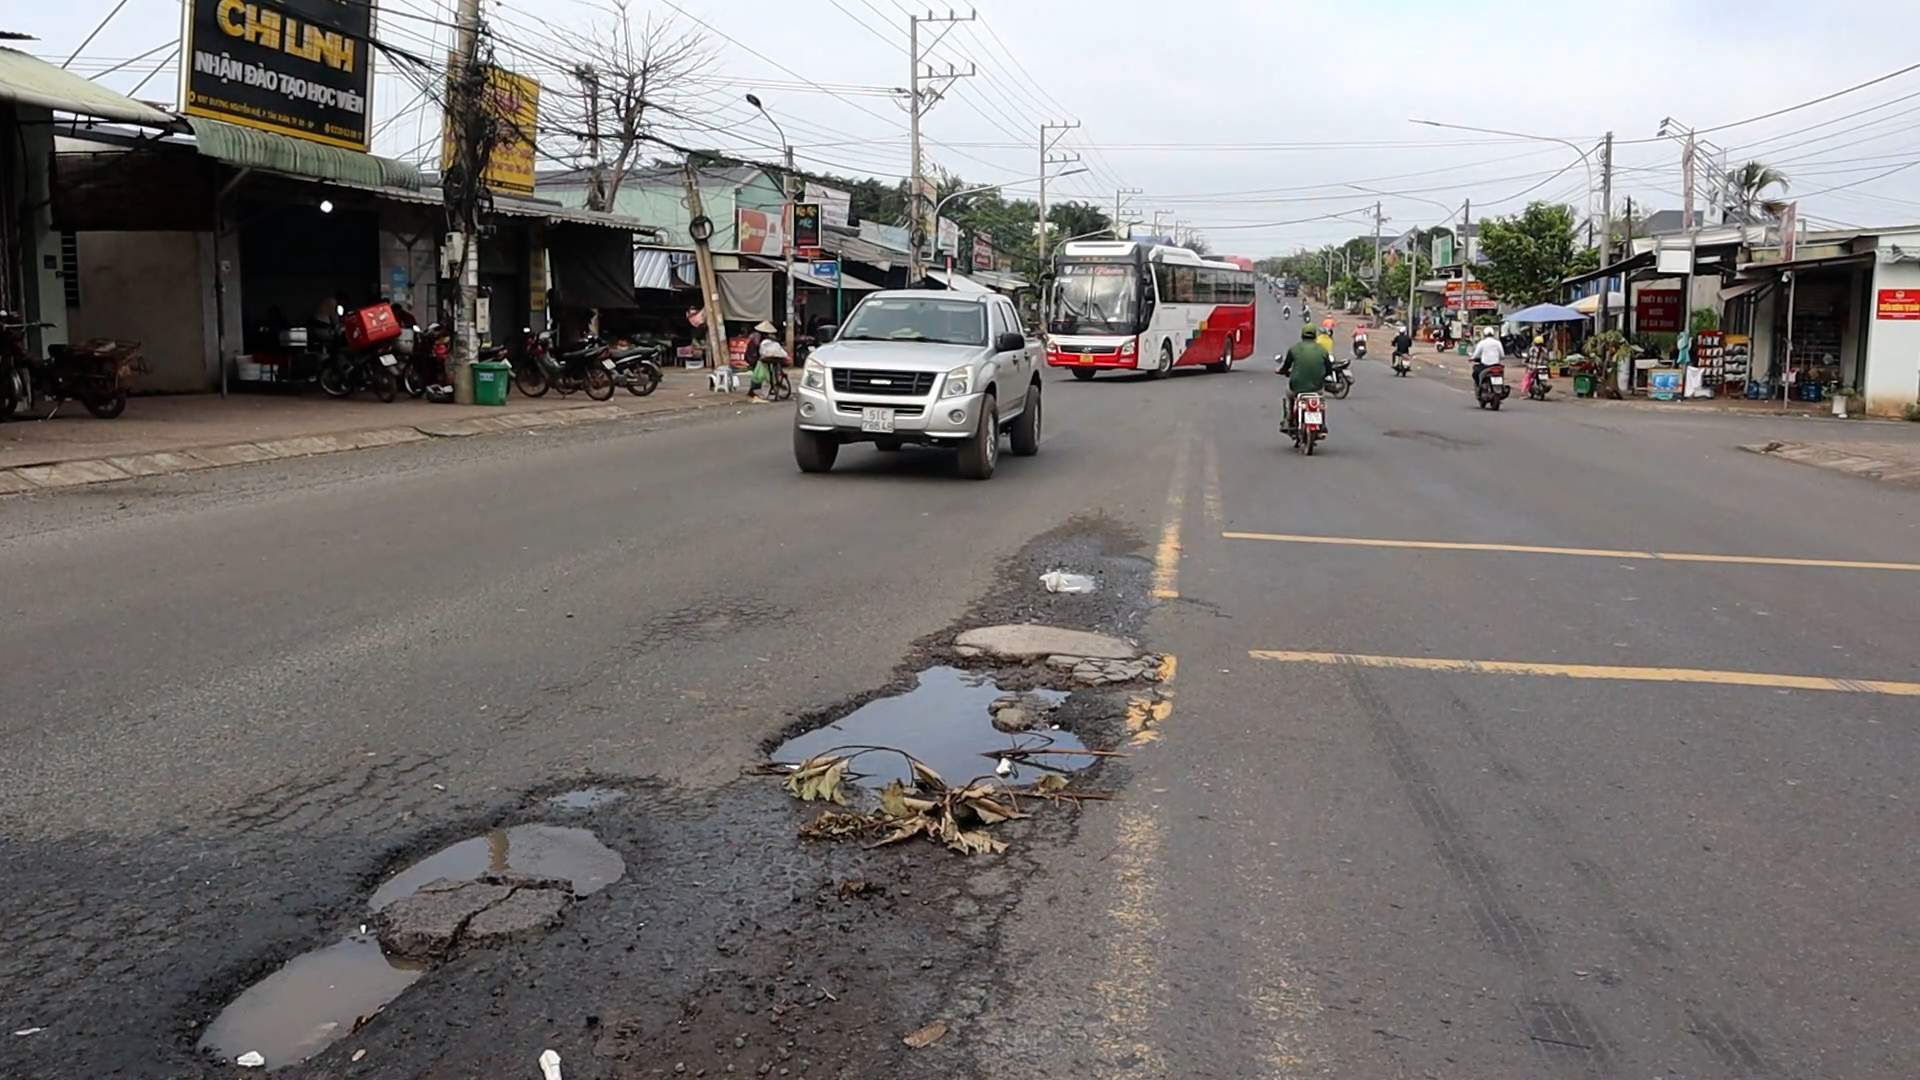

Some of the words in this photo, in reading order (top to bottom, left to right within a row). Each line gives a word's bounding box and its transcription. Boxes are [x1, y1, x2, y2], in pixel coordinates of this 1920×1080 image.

[284, 17, 354, 73] LINH
[195, 51, 242, 84] NHẬN
[244, 62, 278, 91] ĐÀO
[279, 74, 306, 100] TẠO
[307, 82, 336, 109] HỌC
[337, 89, 364, 114] VIÊN
[869, 410, 887, 421] 51C
